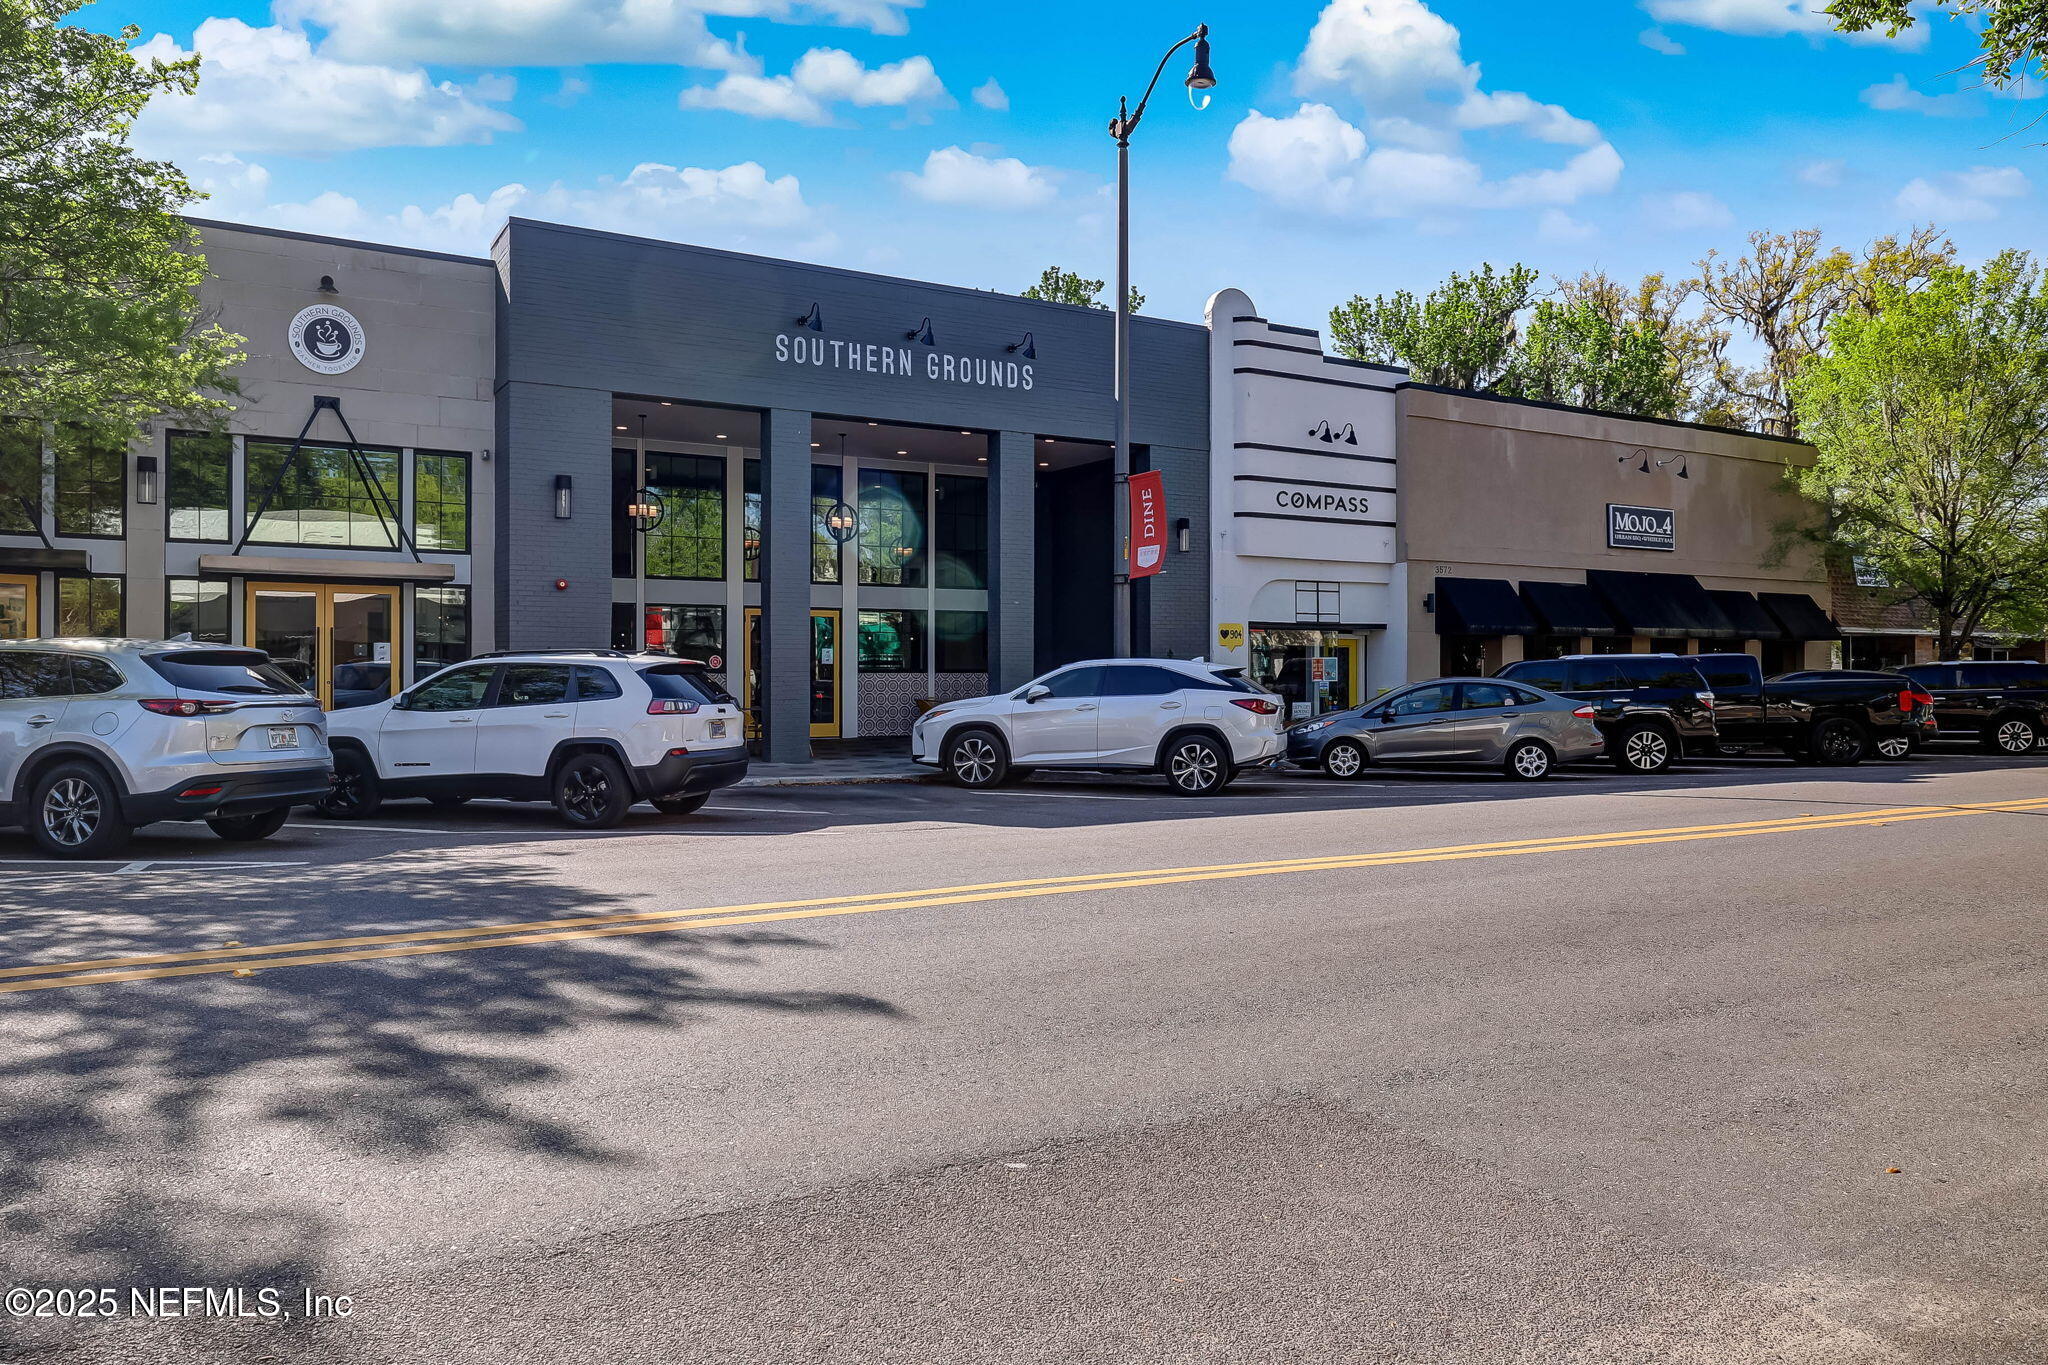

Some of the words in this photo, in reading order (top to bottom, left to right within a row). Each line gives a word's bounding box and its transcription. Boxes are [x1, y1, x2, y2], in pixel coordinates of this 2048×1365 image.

[292, 307, 329, 339] SOUTHERN
[331, 308, 363, 346] GROUNDS
[775, 334, 912, 376] SOUTHERN
[927, 353, 1034, 391] GROUNDS
[1141, 488, 1155, 539] DINE
[1276, 490, 1369, 514] COMPASS
[1614, 511, 1657, 533] MOJO
[1662, 516, 1672, 534] 4
[1434, 565, 1452, 574] 3572
[1230, 629, 1242, 639] 904
